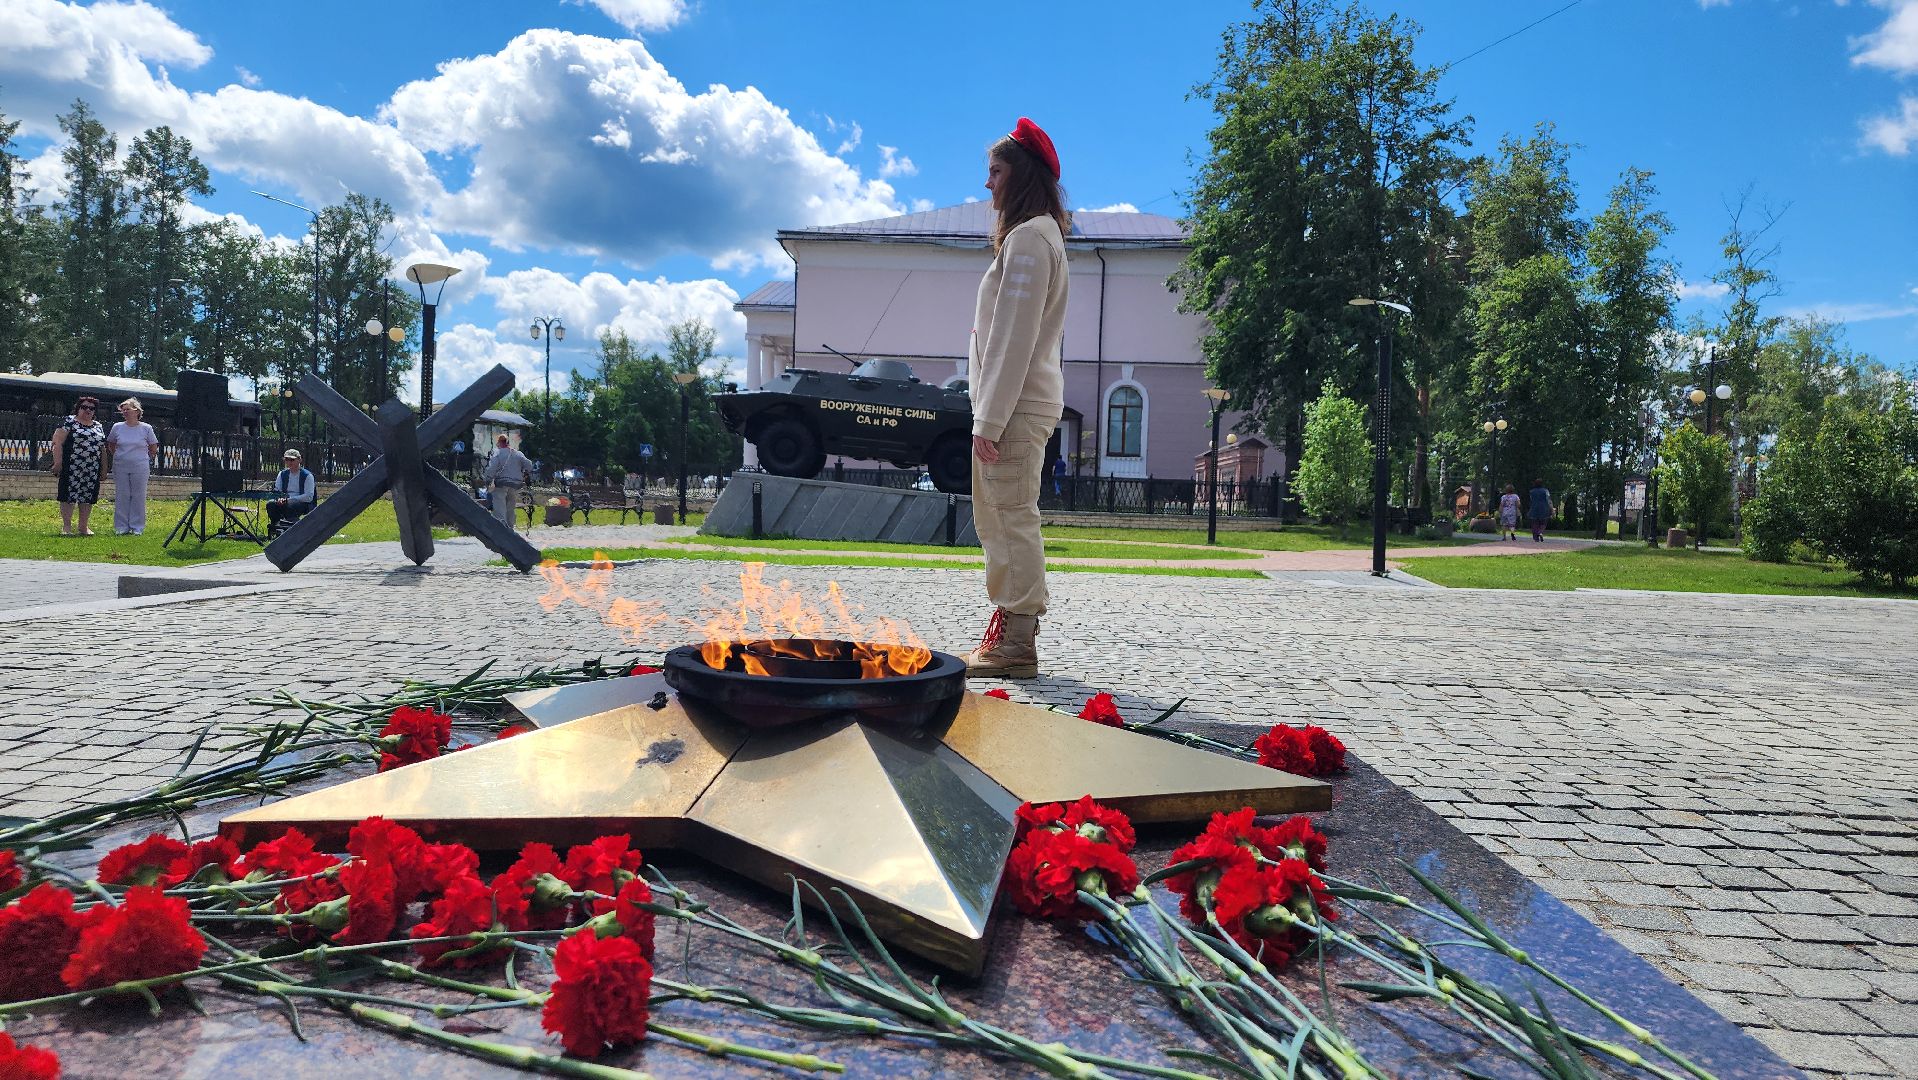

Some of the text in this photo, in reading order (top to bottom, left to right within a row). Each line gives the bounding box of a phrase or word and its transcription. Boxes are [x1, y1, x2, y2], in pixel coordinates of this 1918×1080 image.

[820, 399, 936, 420] ВООРУЖЕННЫЕ СИЛЫ
[856, 415, 898, 427] СА и РФ
